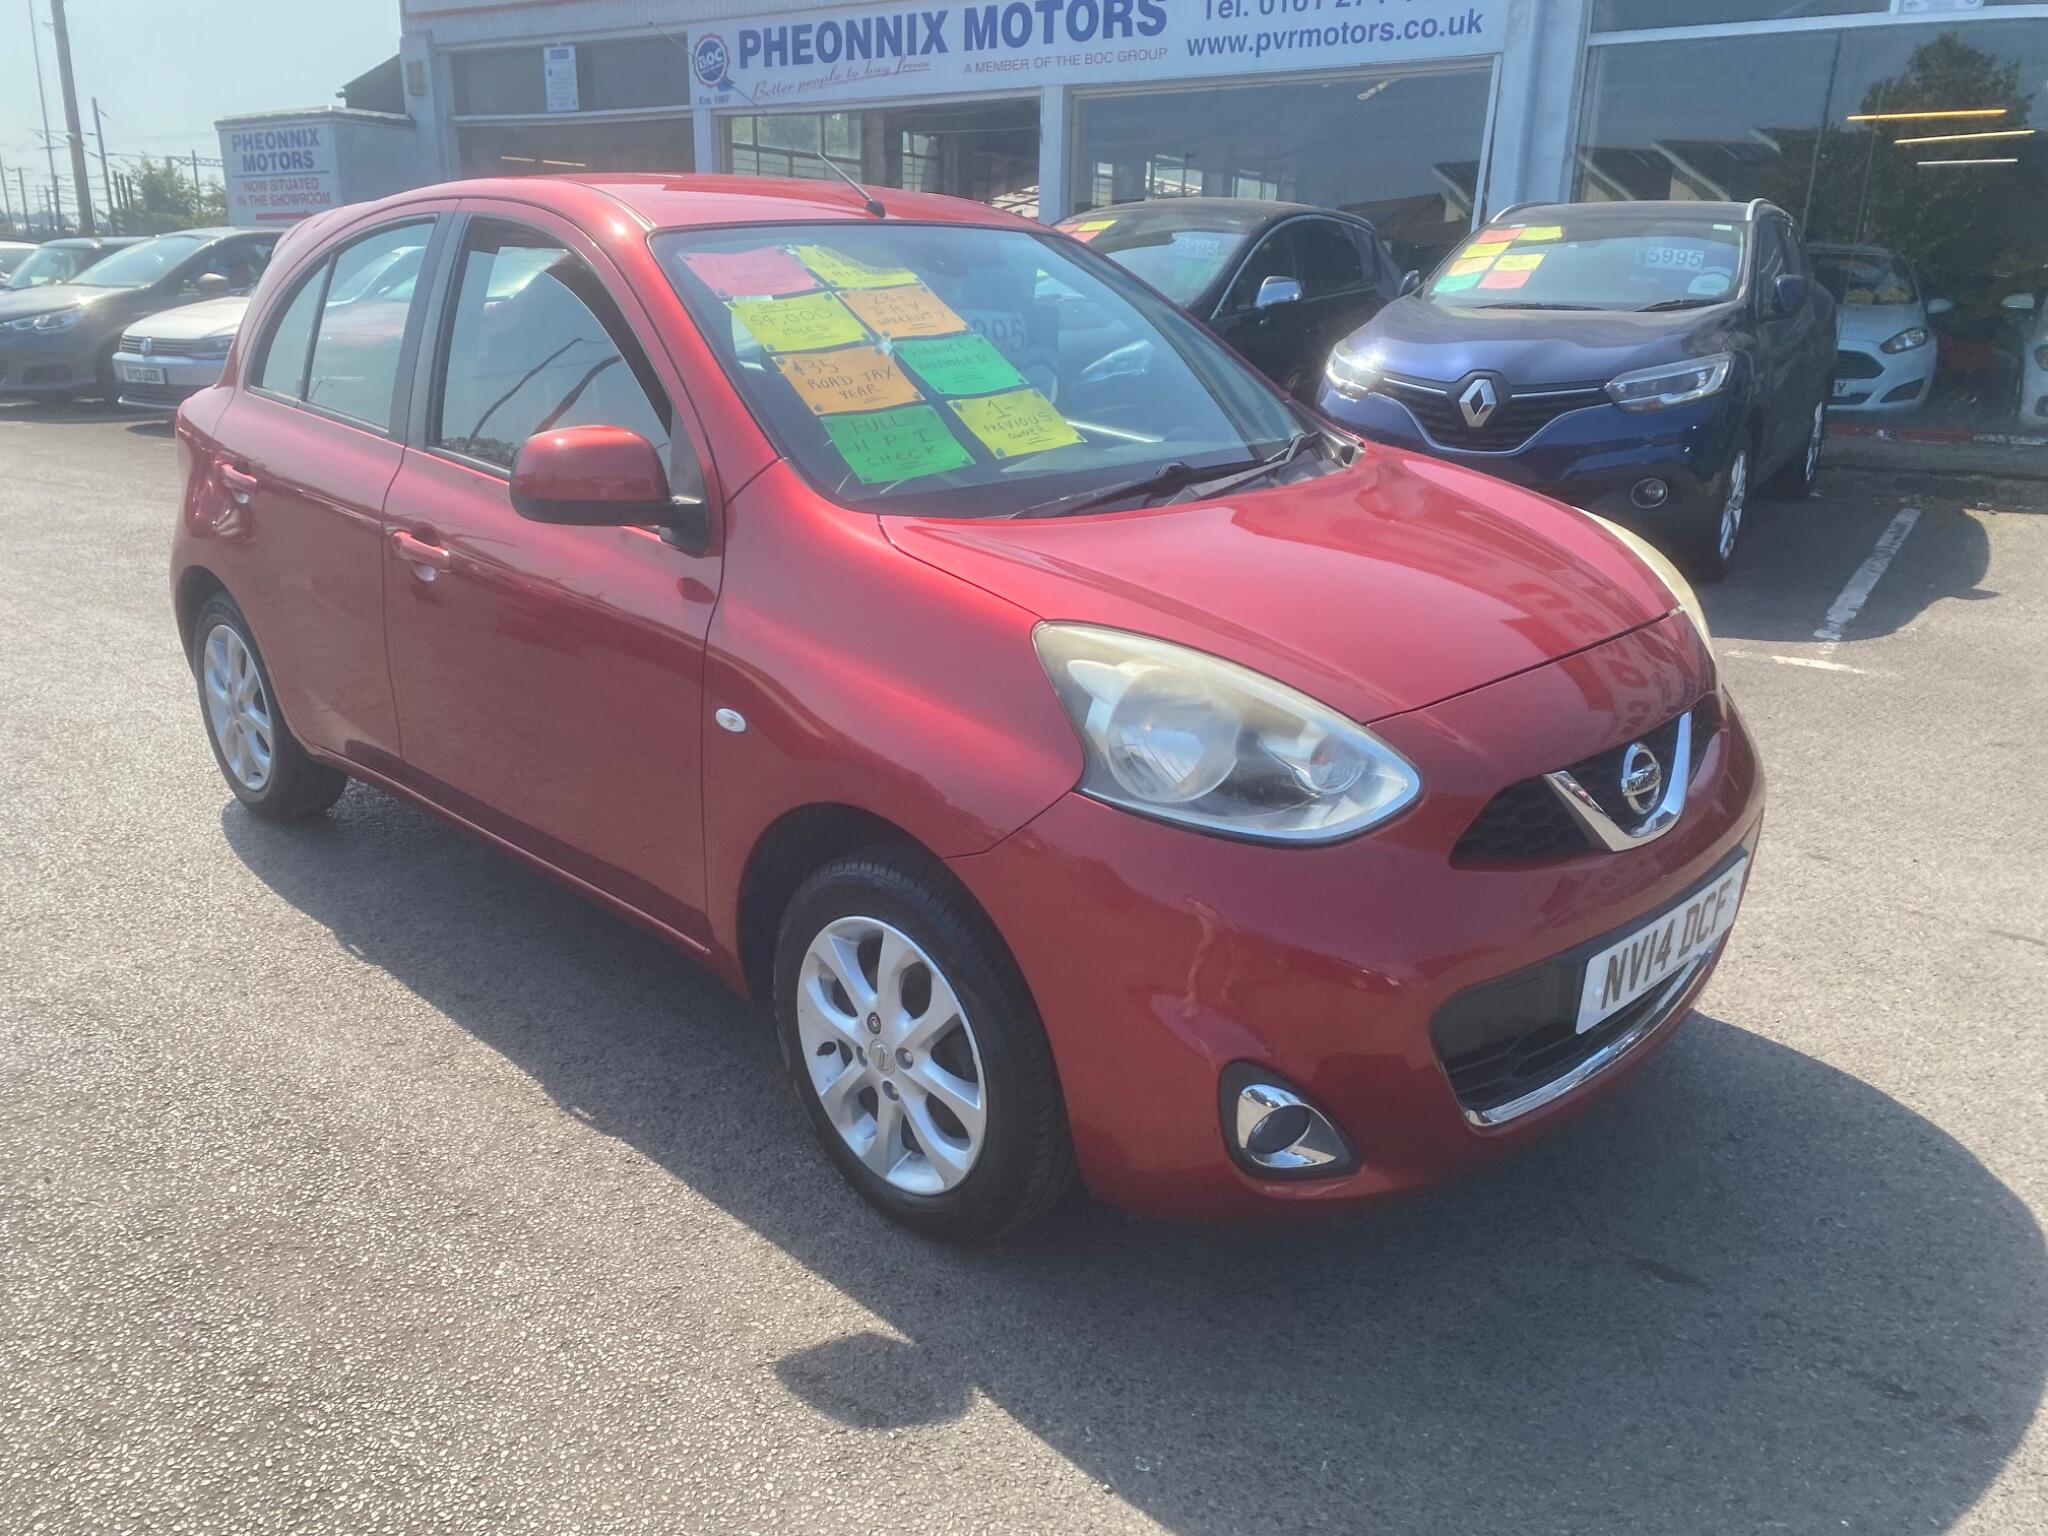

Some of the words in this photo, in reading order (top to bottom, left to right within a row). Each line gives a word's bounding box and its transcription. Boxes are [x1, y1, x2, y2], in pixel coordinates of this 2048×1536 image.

[738, 10, 949, 69] PHEONNIX
[964, 0, 1168, 51] MOTORS
[1187, 8, 1484, 57] www.pvrmotors.co.uk
[697, 46, 724, 70] BOC
[963, 63, 973, 74] A
[975, 58, 1029, 73] MEMBER
[1034, 56, 1051, 69] OF
[1055, 54, 1081, 67] THE
[1084, 51, 1114, 65] BOC
[1117, 47, 1168, 62] GROUP
[751, 80, 793, 100] Better
[798, 65, 841, 93] people
[846, 67, 860, 79] to
[896, 54, 930, 75] from
[231, 127, 321, 152] PHEONNIX
[242, 150, 314, 172] MOTORS
[243, 180, 268, 192] NOW
[269, 177, 319, 192] SITUATED
[248, 194, 268, 207] THE
[269, 191, 331, 206] SHOWROOM
[1647, 248, 1702, 267] 5995
[807, 376, 853, 390] ROAD
[860, 365, 896, 382] TAX
[839, 383, 881, 400] YEAR
[850, 415, 910, 434] FULL
[983, 411, 1053, 433] PREVIOUS
[1600, 918, 1675, 1010] NV14
[1676, 878, 1732, 958] DCF
